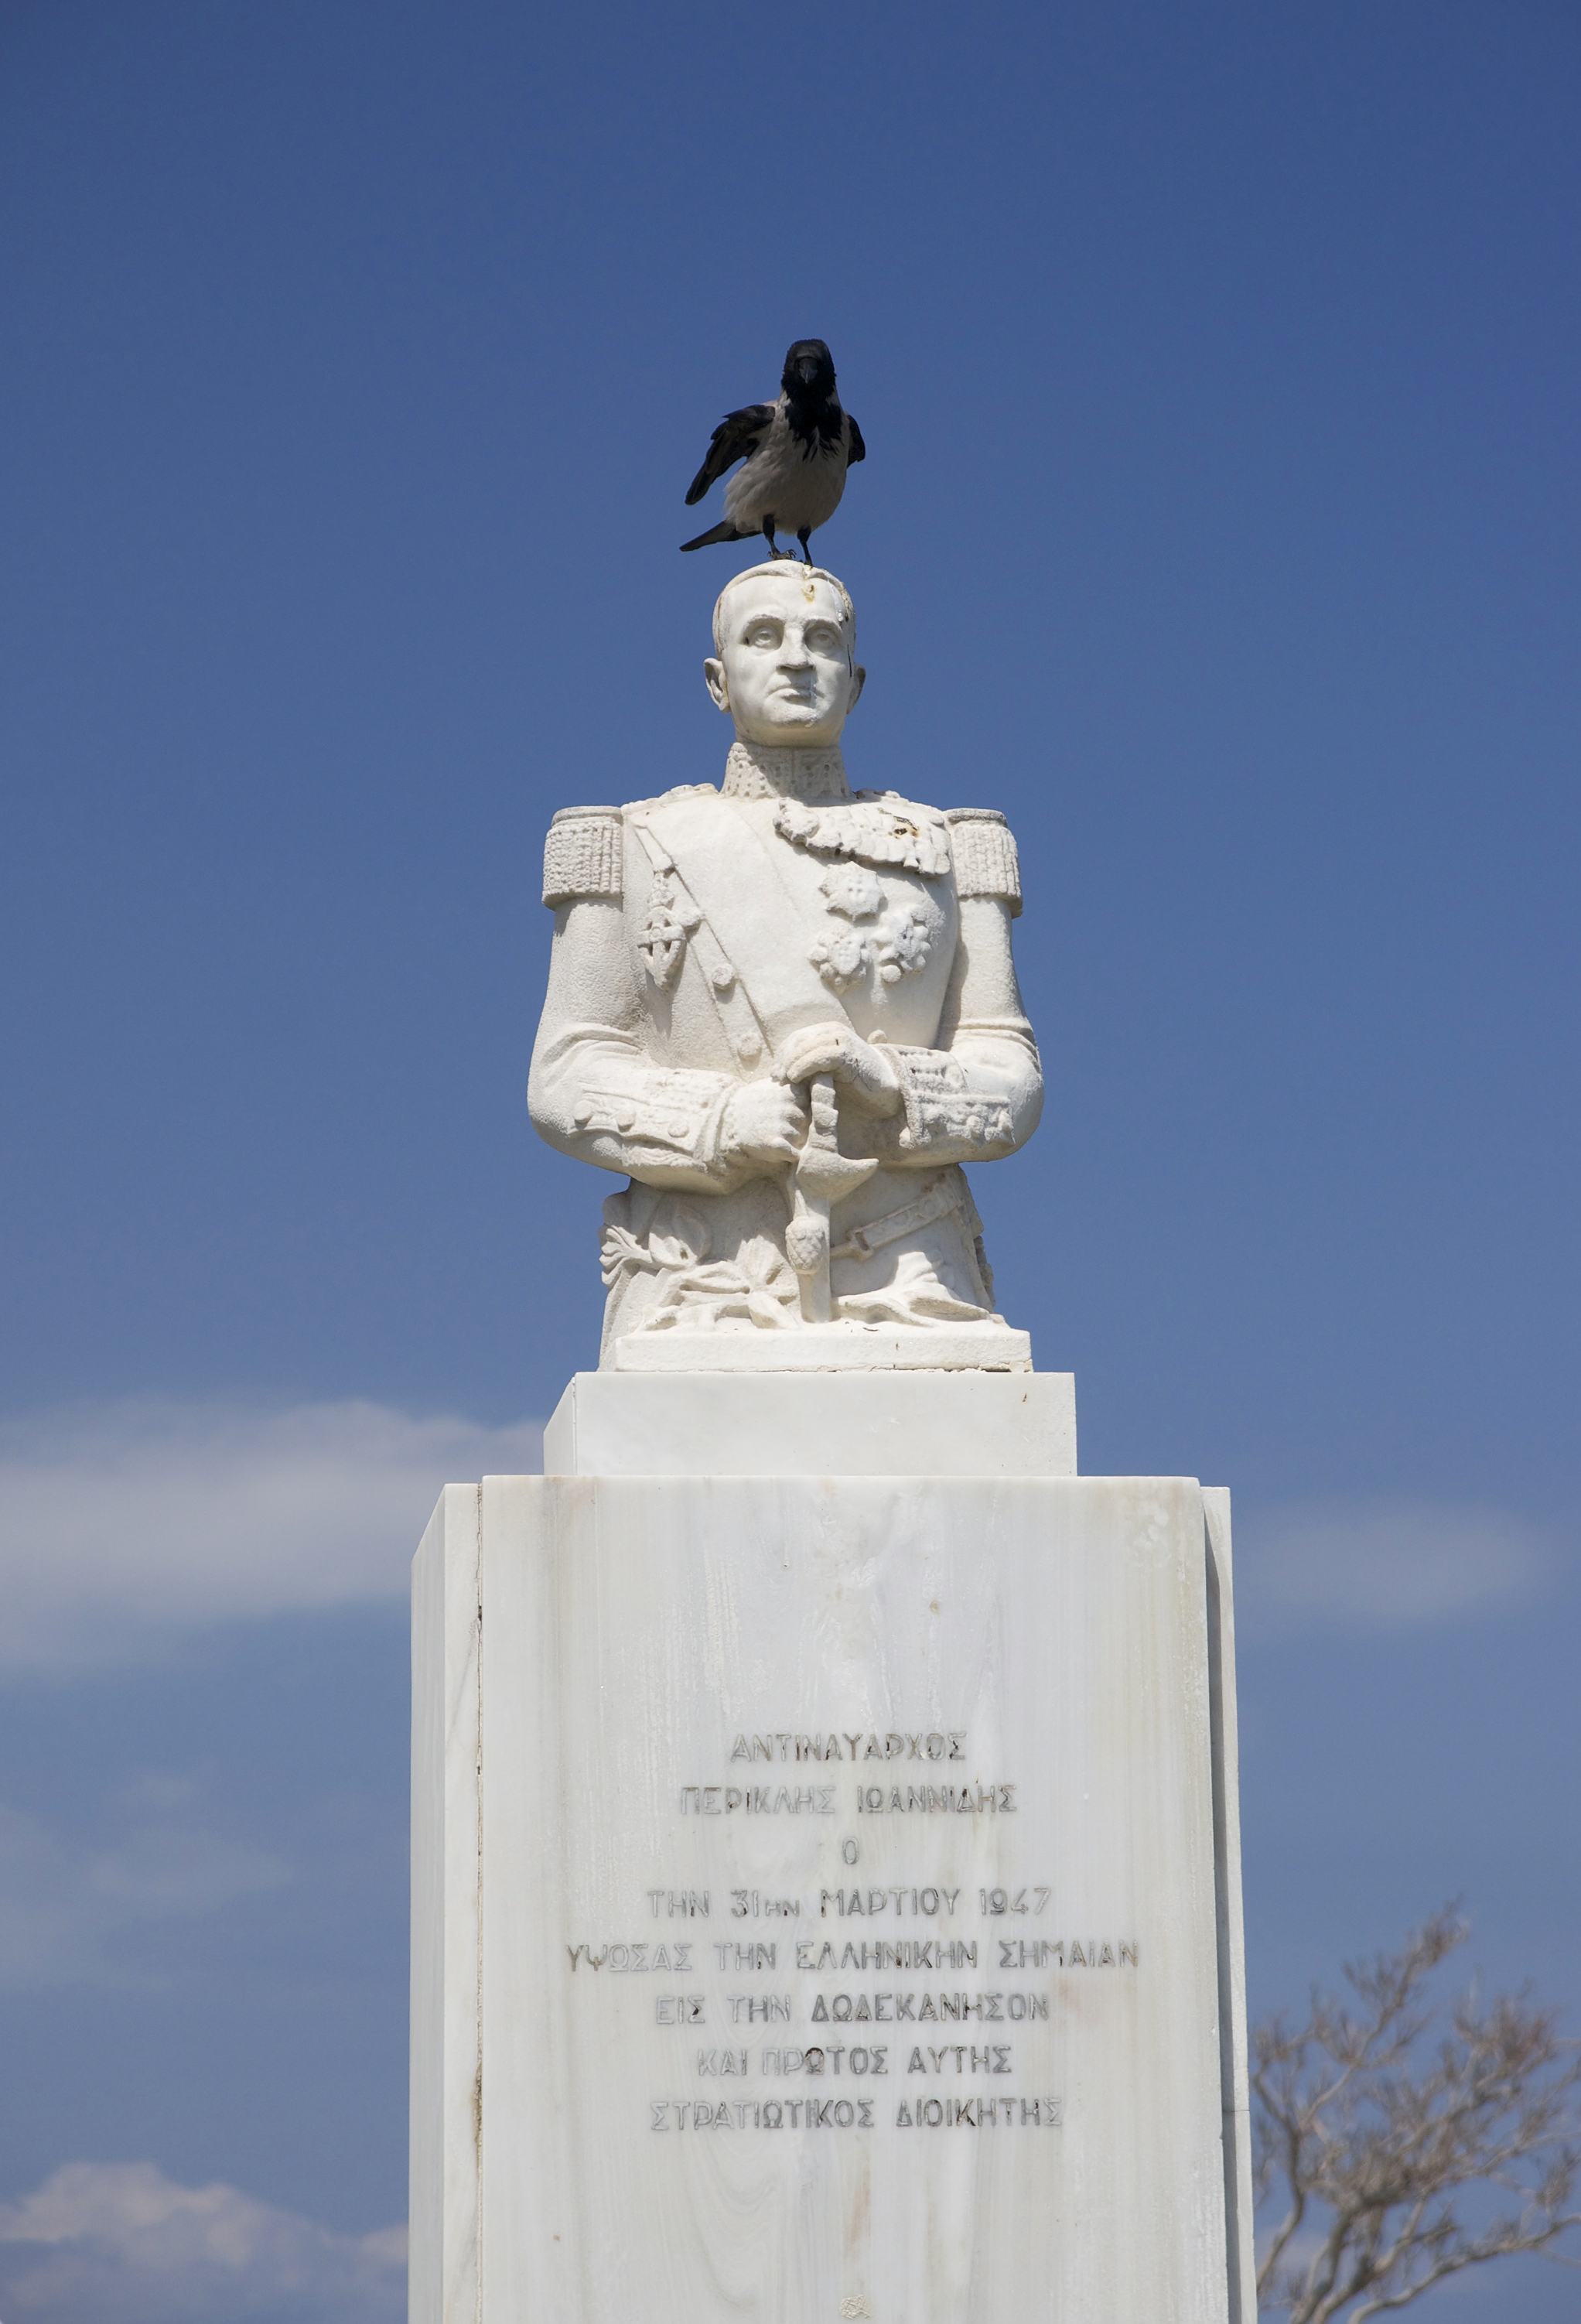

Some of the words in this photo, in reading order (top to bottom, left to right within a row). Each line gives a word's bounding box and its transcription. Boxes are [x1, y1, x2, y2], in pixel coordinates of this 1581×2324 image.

[729, 1732, 967, 1763] ΑΝΤΙΝΑΥΑΡΧΟΣ
[680, 1786, 836, 1815] ΠΕΡΙΚΛΗΣ
[856, 1784, 1018, 1813] ΙΩΑΝΝΙΔΗΣ
[647, 1890, 710, 1918] ΤΗΝ
[820, 1888, 961, 1916] ΜΑΡΤΙΟΥ
[978, 1887, 1053, 1916] 1947
[565, 1943, 693, 1972] ΥΨΩΣΑΣ
[712, 1942, 776, 1970] ΤΗΝ
[795, 1940, 978, 1970] ΕΛΛΗΝΙΚΗΝ
[998, 1940, 1139, 1969] ΣΗΜΑΙΑΝ
[655, 1995, 706, 2025] ΕΙΣ
[726, 1994, 790, 2023] ΤΗΝ
[810, 1993, 1050, 2022] ΔΩΔΕΚΑΝΗΣΟΝ
[698, 2047, 748, 2076] ΚΑΙ
[761, 2045, 890, 2076] ΠΡΩΤΟΣ
[907, 2045, 1012, 2075] ΑΥΤΗΣ
[650, 2099, 876, 2131] ΣΤΡΑΤΙΩΤΙΚΟΣ
[896, 2097, 1063, 2127] ΔΙΟΙΚΗΤΗΣ
